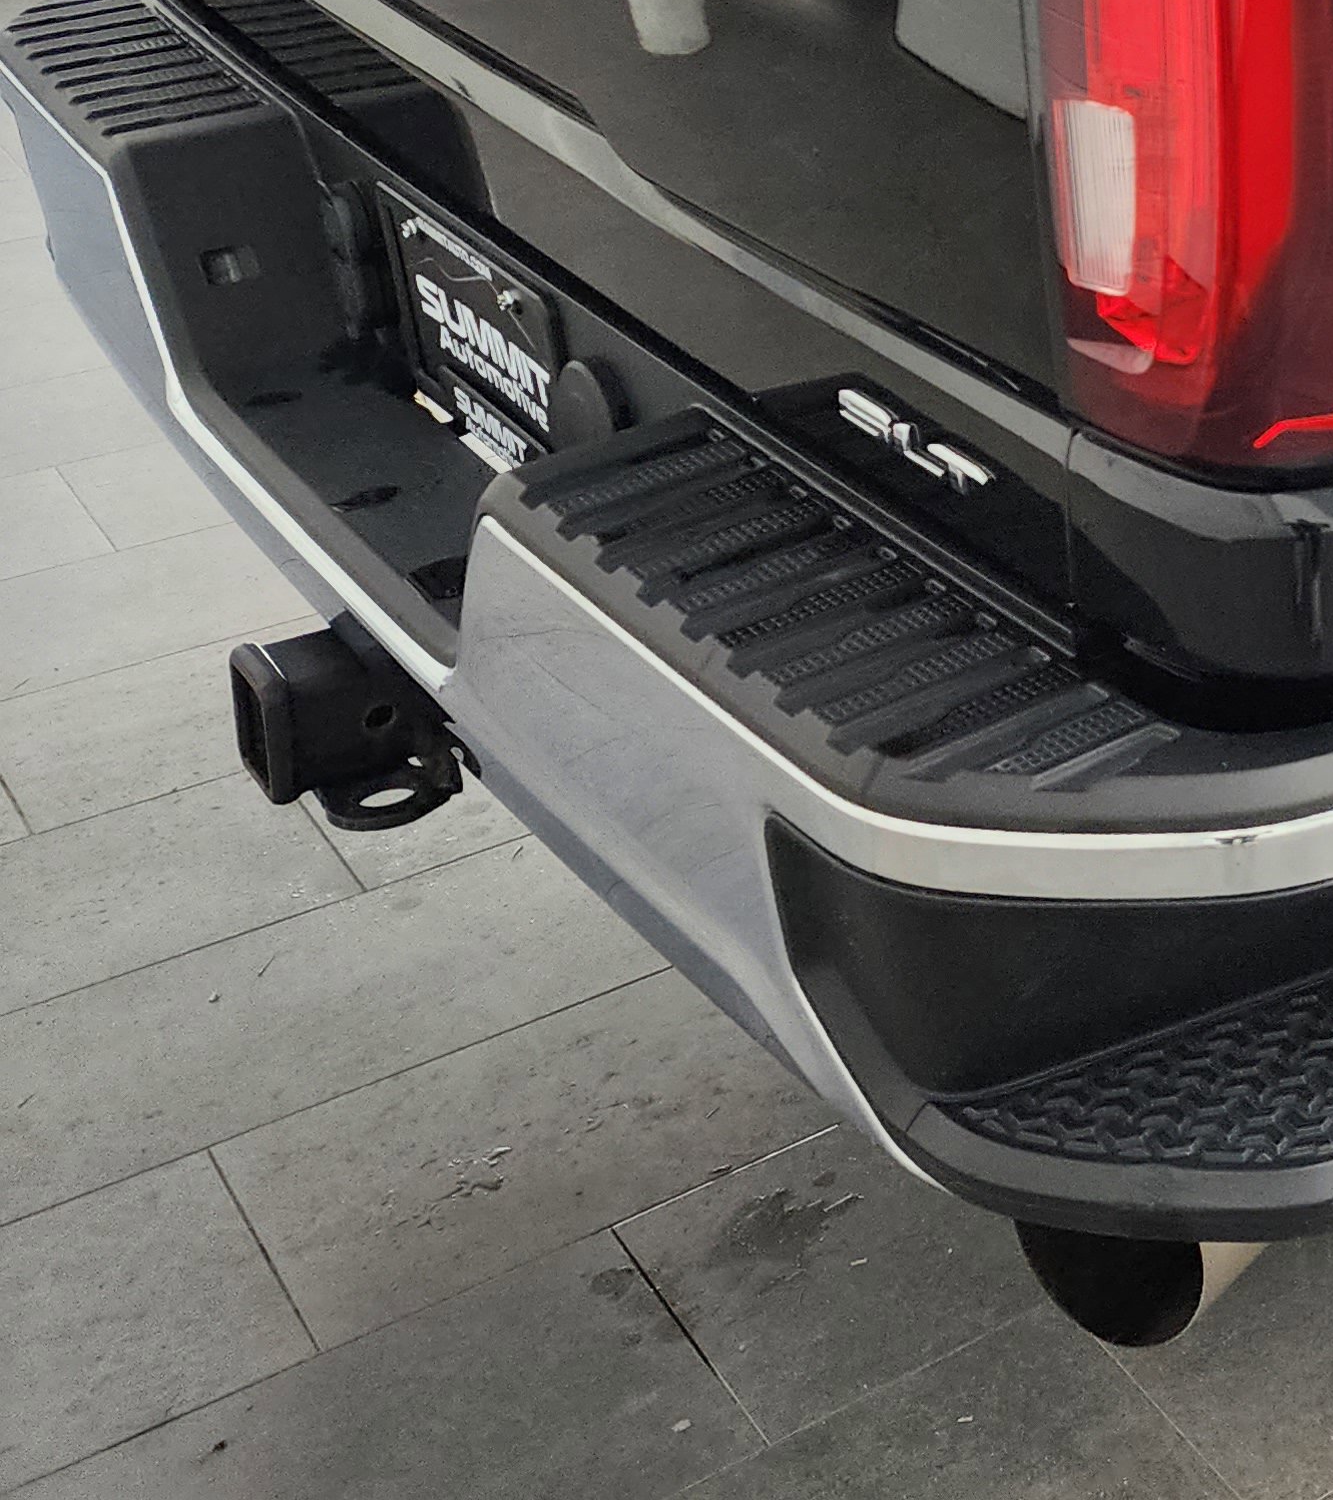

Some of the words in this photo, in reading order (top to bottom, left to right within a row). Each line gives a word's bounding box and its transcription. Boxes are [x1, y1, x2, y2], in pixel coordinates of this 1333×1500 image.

[415, 273, 550, 408] SUMMIT
[440, 325, 550, 433] Automotive
[453, 386, 528, 463] SUMMIT
[837, 387, 995, 496] SLT
